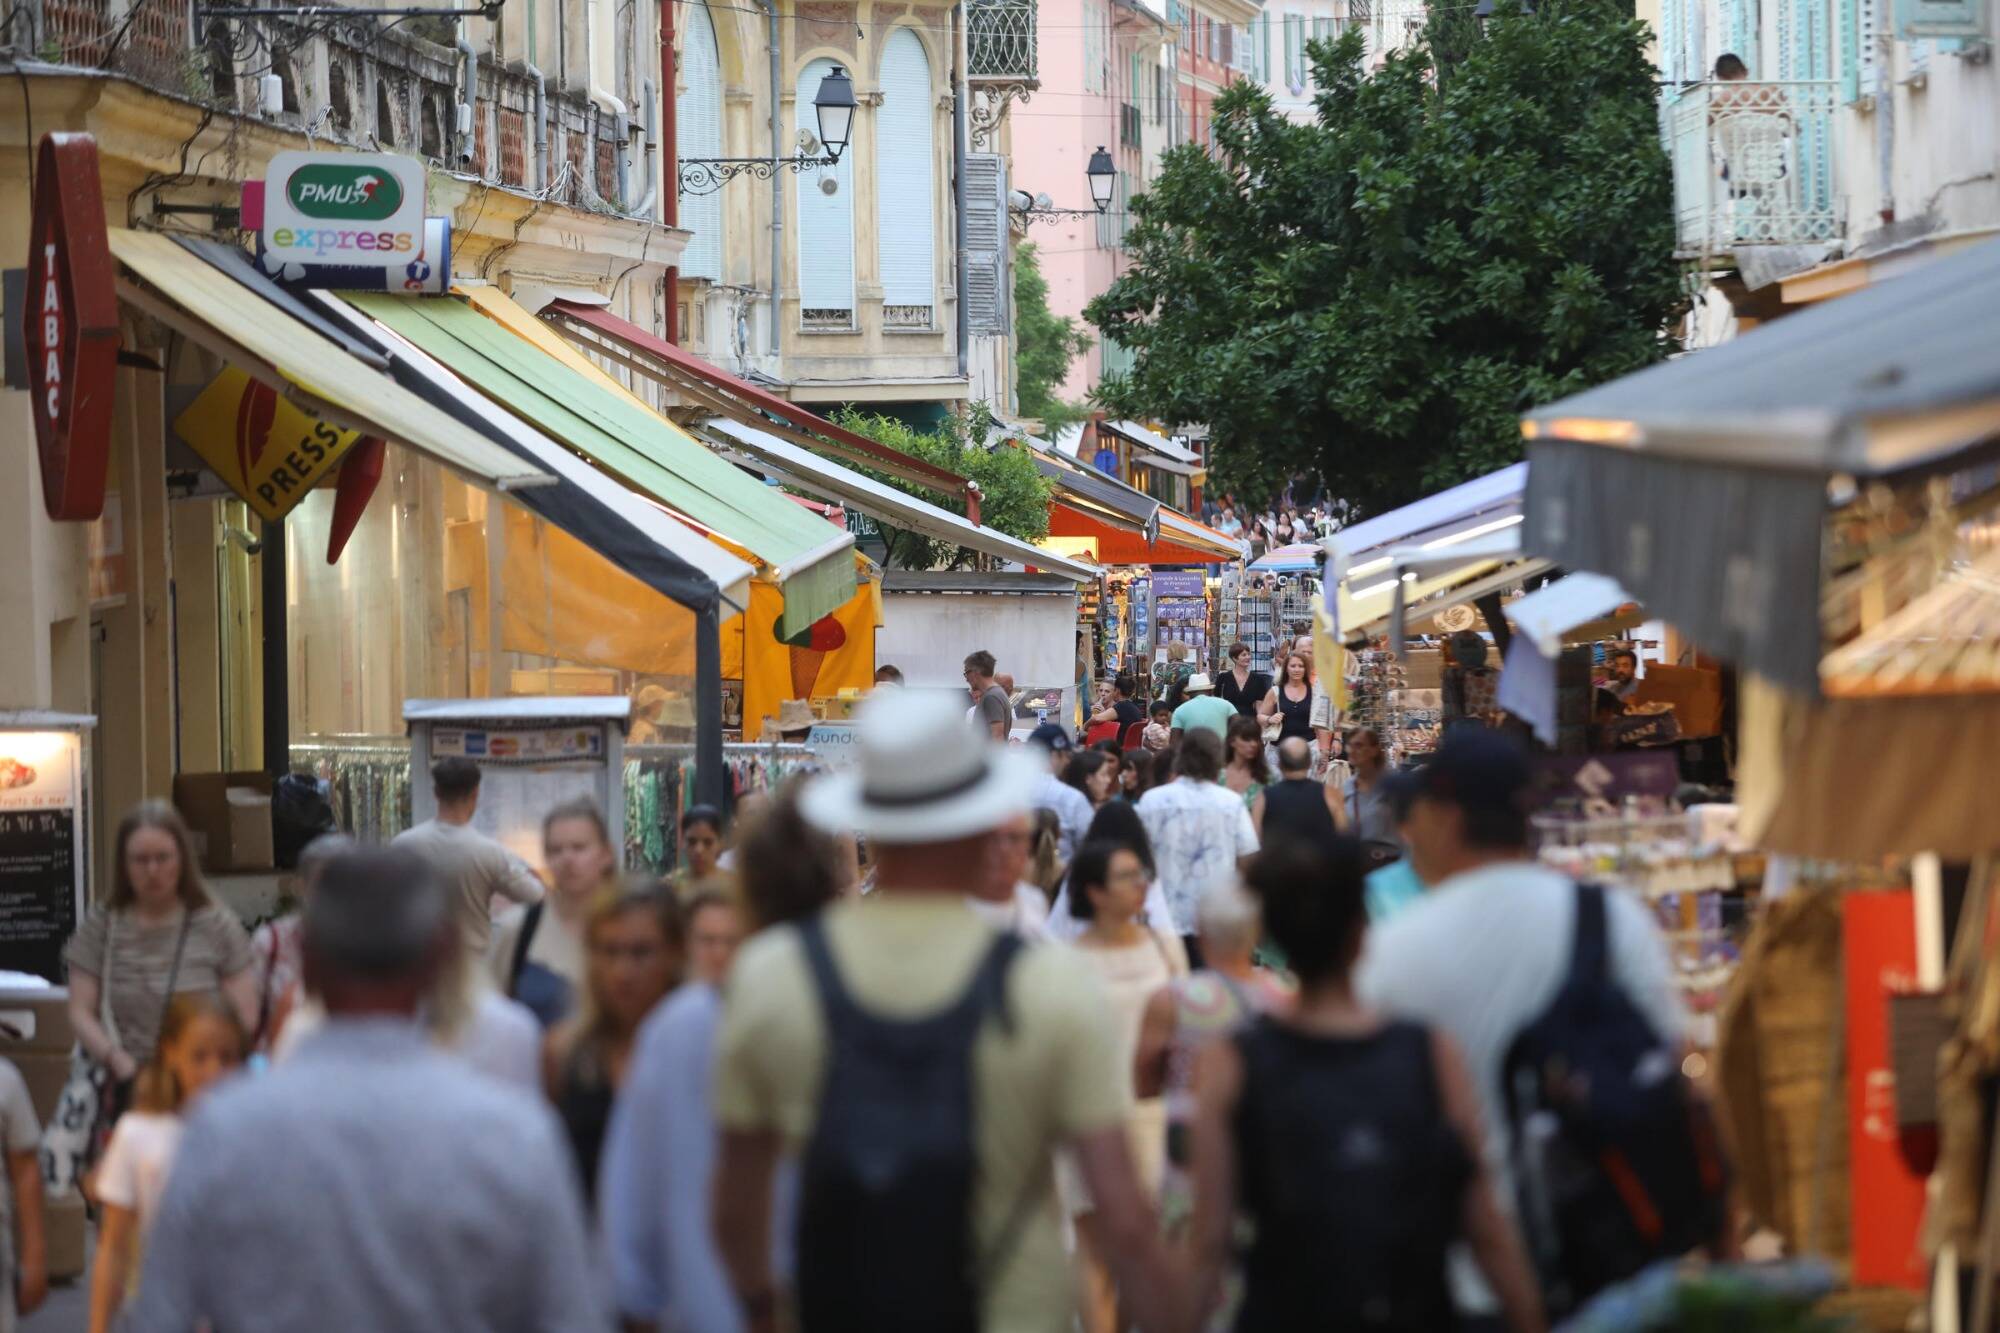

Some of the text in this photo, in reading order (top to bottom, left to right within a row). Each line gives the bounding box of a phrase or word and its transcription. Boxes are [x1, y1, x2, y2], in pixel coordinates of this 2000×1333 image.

[299, 183, 351, 204] PMU
[273, 228, 415, 256] express
[44, 243, 61, 419] TABAC
[257, 421, 350, 508] PRESS
